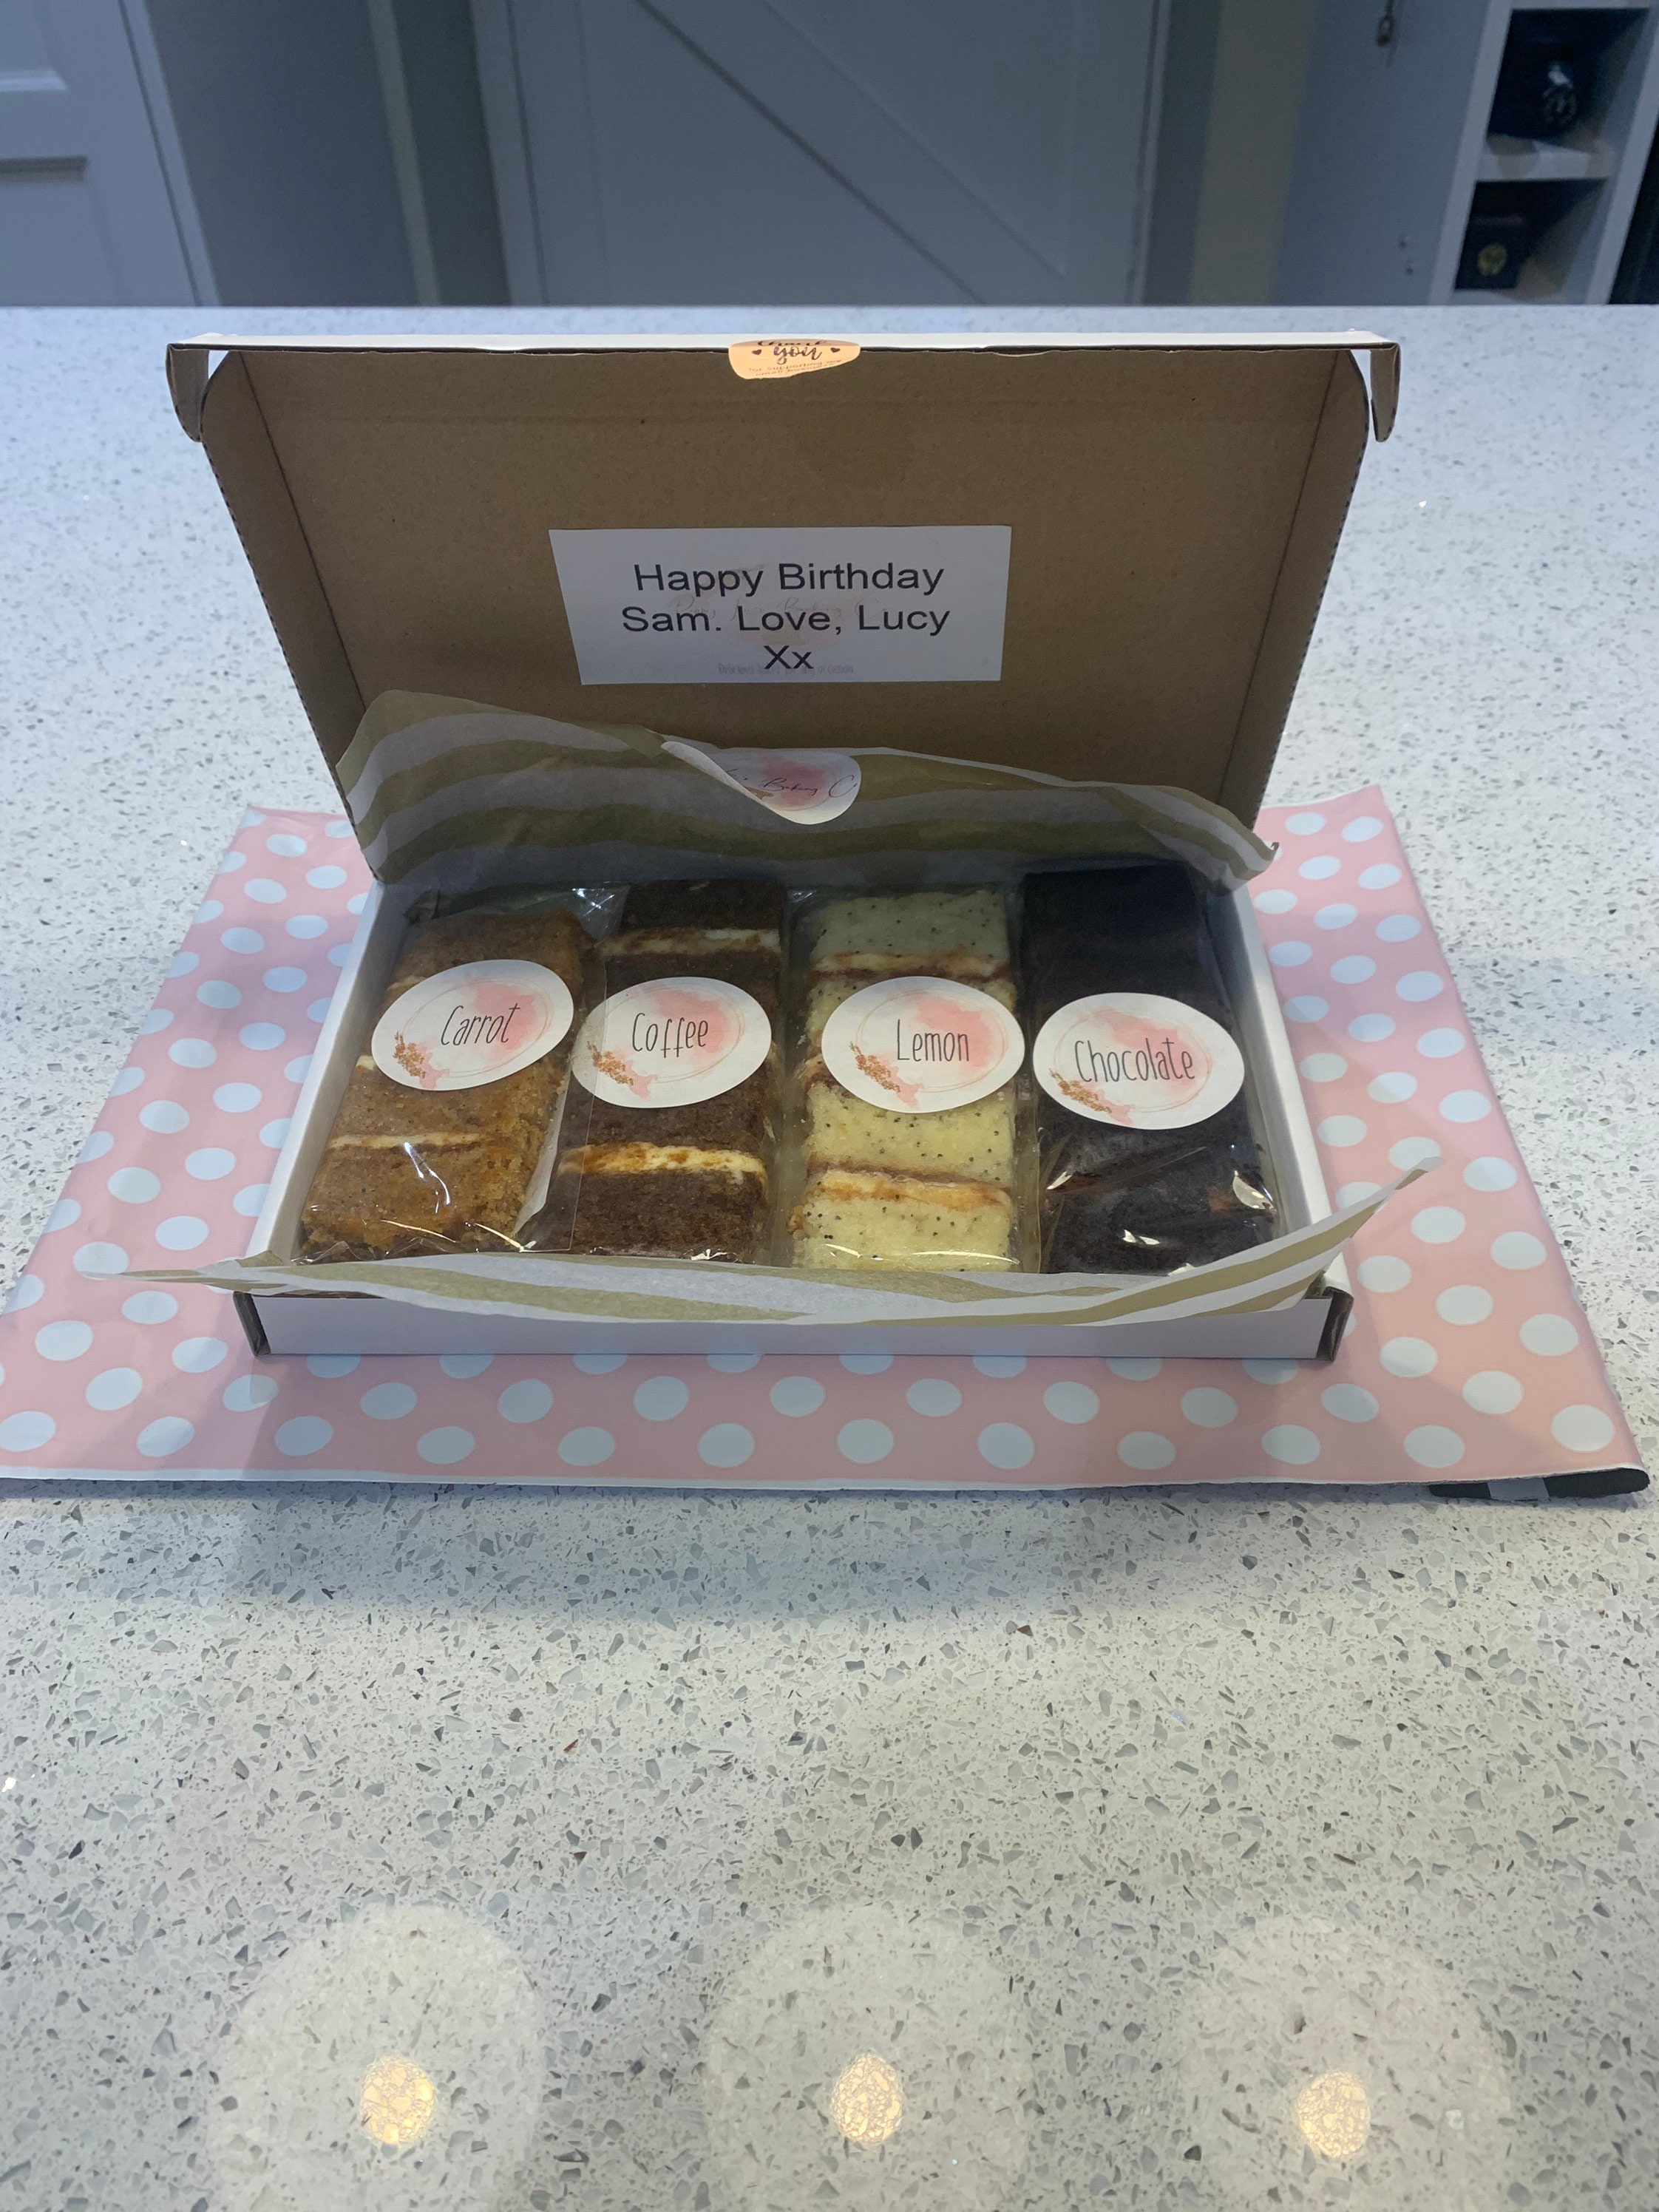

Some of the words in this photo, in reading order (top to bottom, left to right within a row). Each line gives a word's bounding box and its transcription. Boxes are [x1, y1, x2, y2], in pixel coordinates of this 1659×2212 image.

[773, 346, 823, 365] you
[634, 564, 764, 597] Happy
[778, 562, 946, 596] Birthday
[622, 606, 722, 632] Sam.
[738, 605, 841, 635] Love,
[858, 604, 951, 637] Lucy
[763, 645, 814, 670] Xx
[441, 1002, 520, 1046] Carrot
[632, 1012, 708, 1059] Coffee
[897, 1019, 970, 1062] Lemon
[1074, 1037, 1195, 1083] Chocolate
